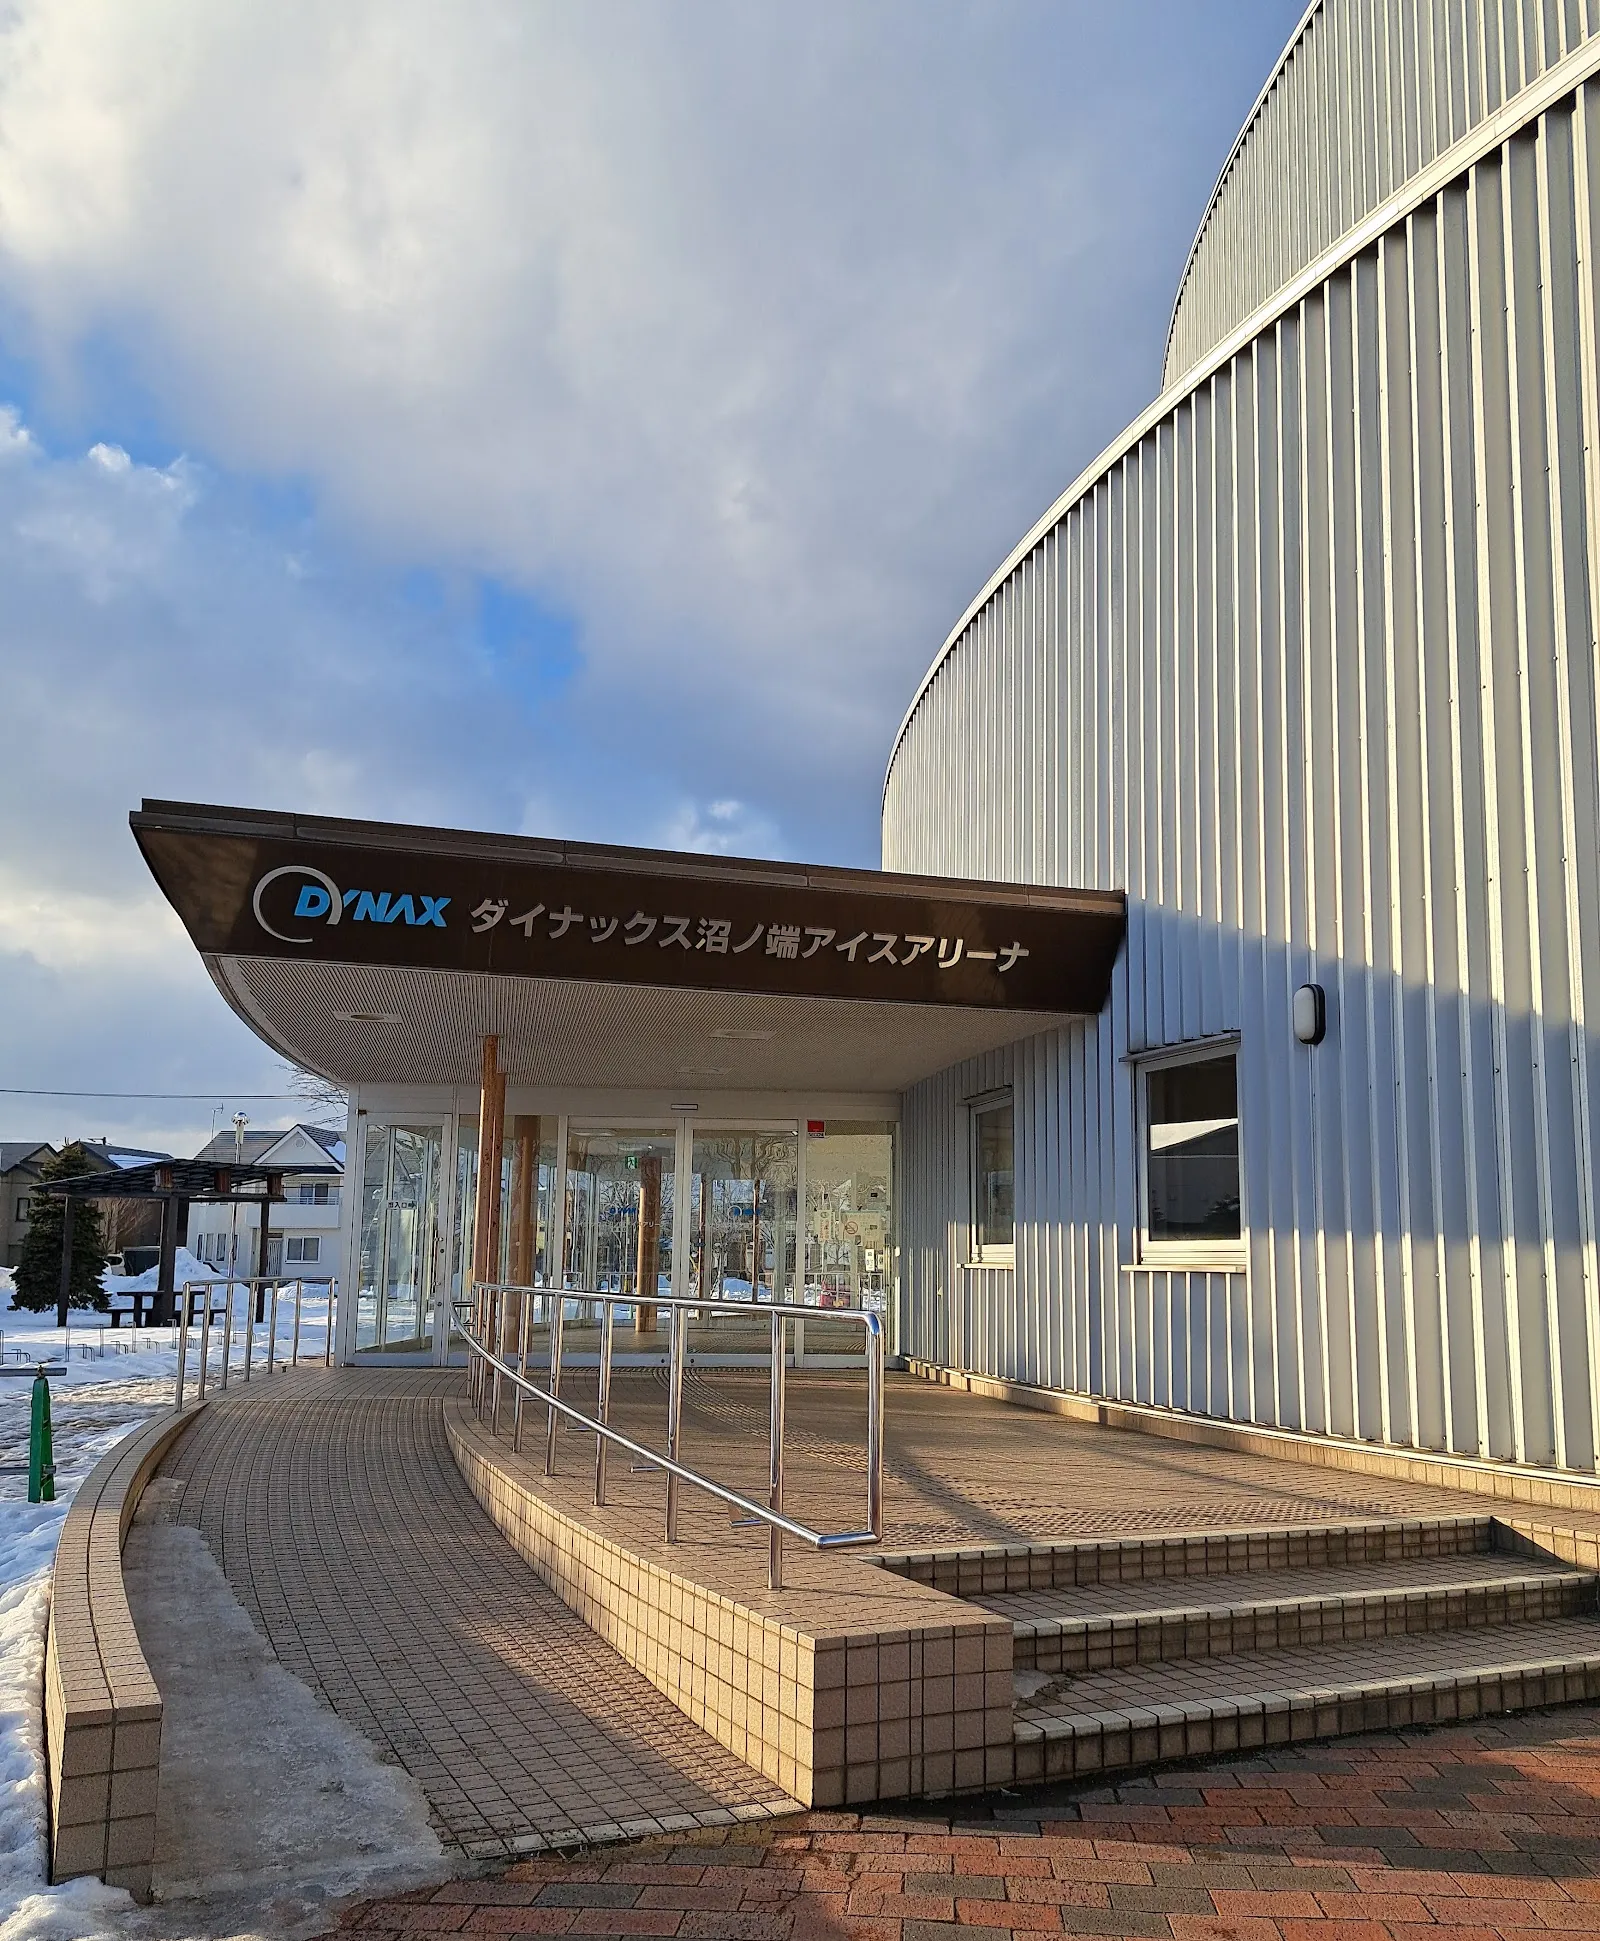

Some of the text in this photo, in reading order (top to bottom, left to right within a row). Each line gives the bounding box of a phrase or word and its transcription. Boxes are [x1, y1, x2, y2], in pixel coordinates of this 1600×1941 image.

[293, 884, 452, 928] DYNAX
[469, 897, 1031, 973] ダイナックス沼ノ端アイスアリーナ
